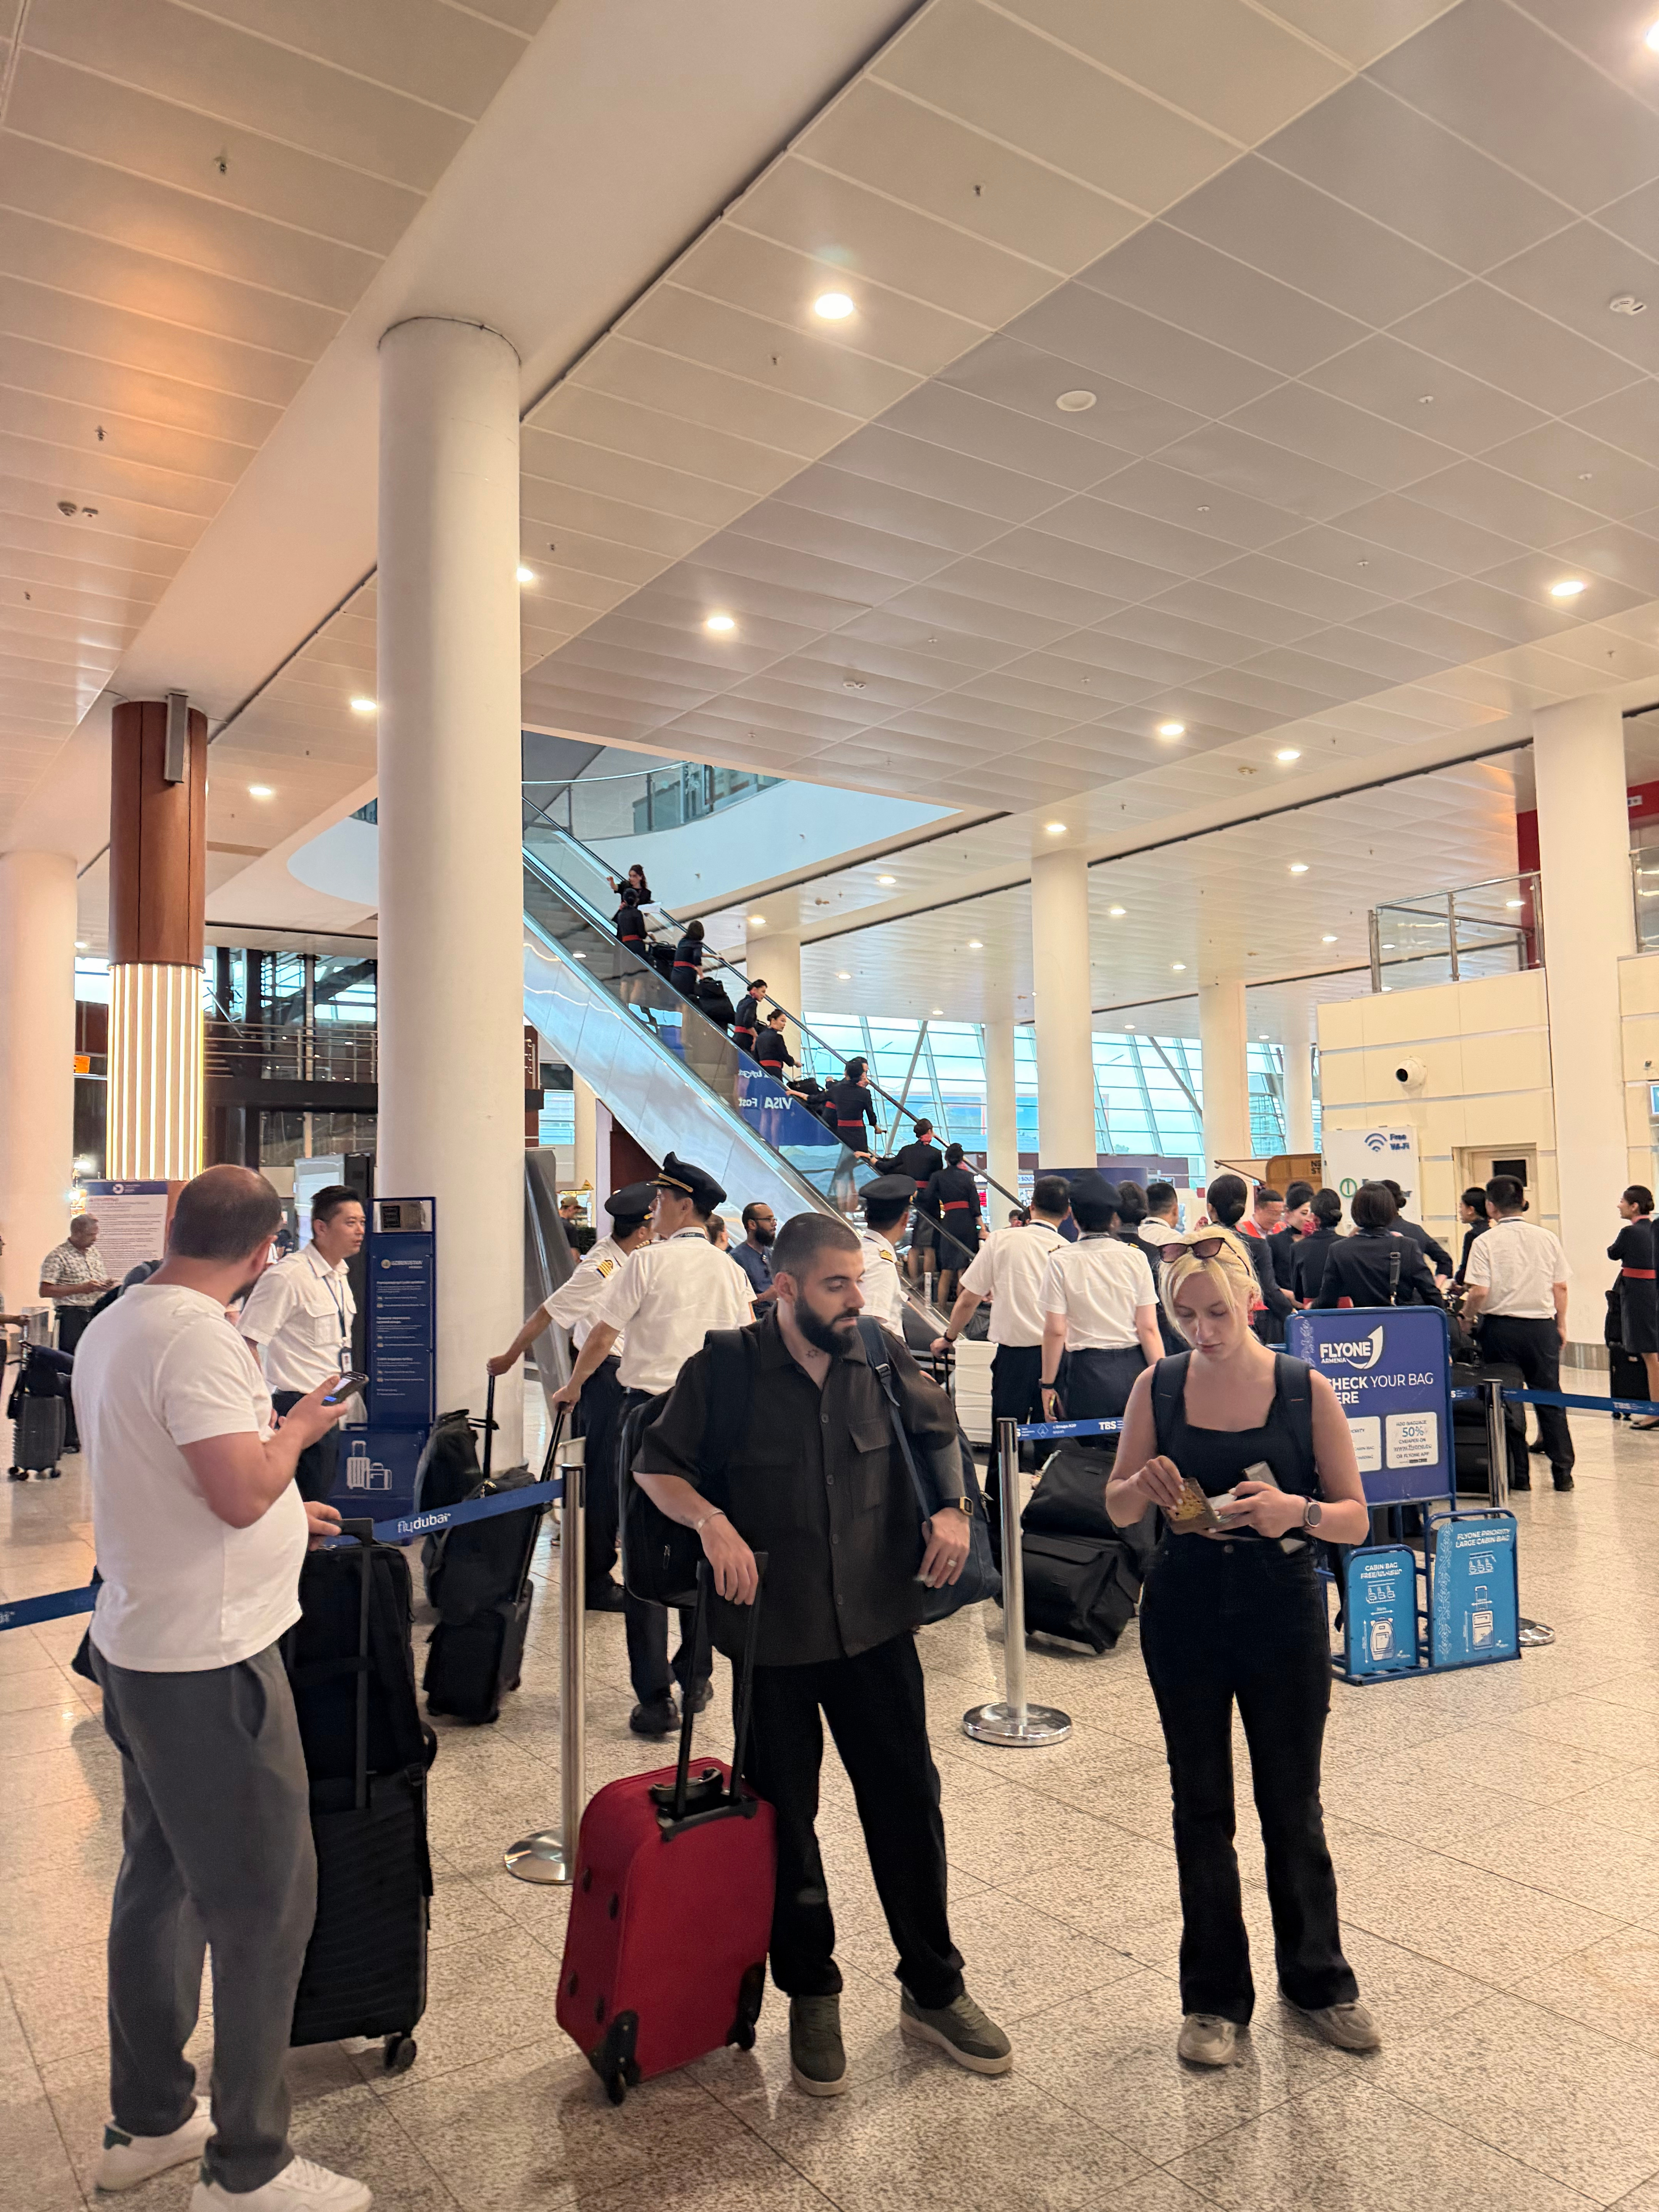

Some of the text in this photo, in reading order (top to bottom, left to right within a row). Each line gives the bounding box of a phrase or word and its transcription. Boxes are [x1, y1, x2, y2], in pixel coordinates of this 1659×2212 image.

[1320, 1341, 1371, 1358] FLYONE
[1370, 1374, 1405, 1388] YOUR
[1408, 1372, 1433, 1386] BAG
[1335, 1391, 1360, 1404] ERE
[1098, 1421, 1116, 1430] TBS
[1402, 1426, 1424, 1437] 50%
[1457, 1531, 1481, 1540] FLYONE
[1456, 1539, 1476, 1548] LARGE
